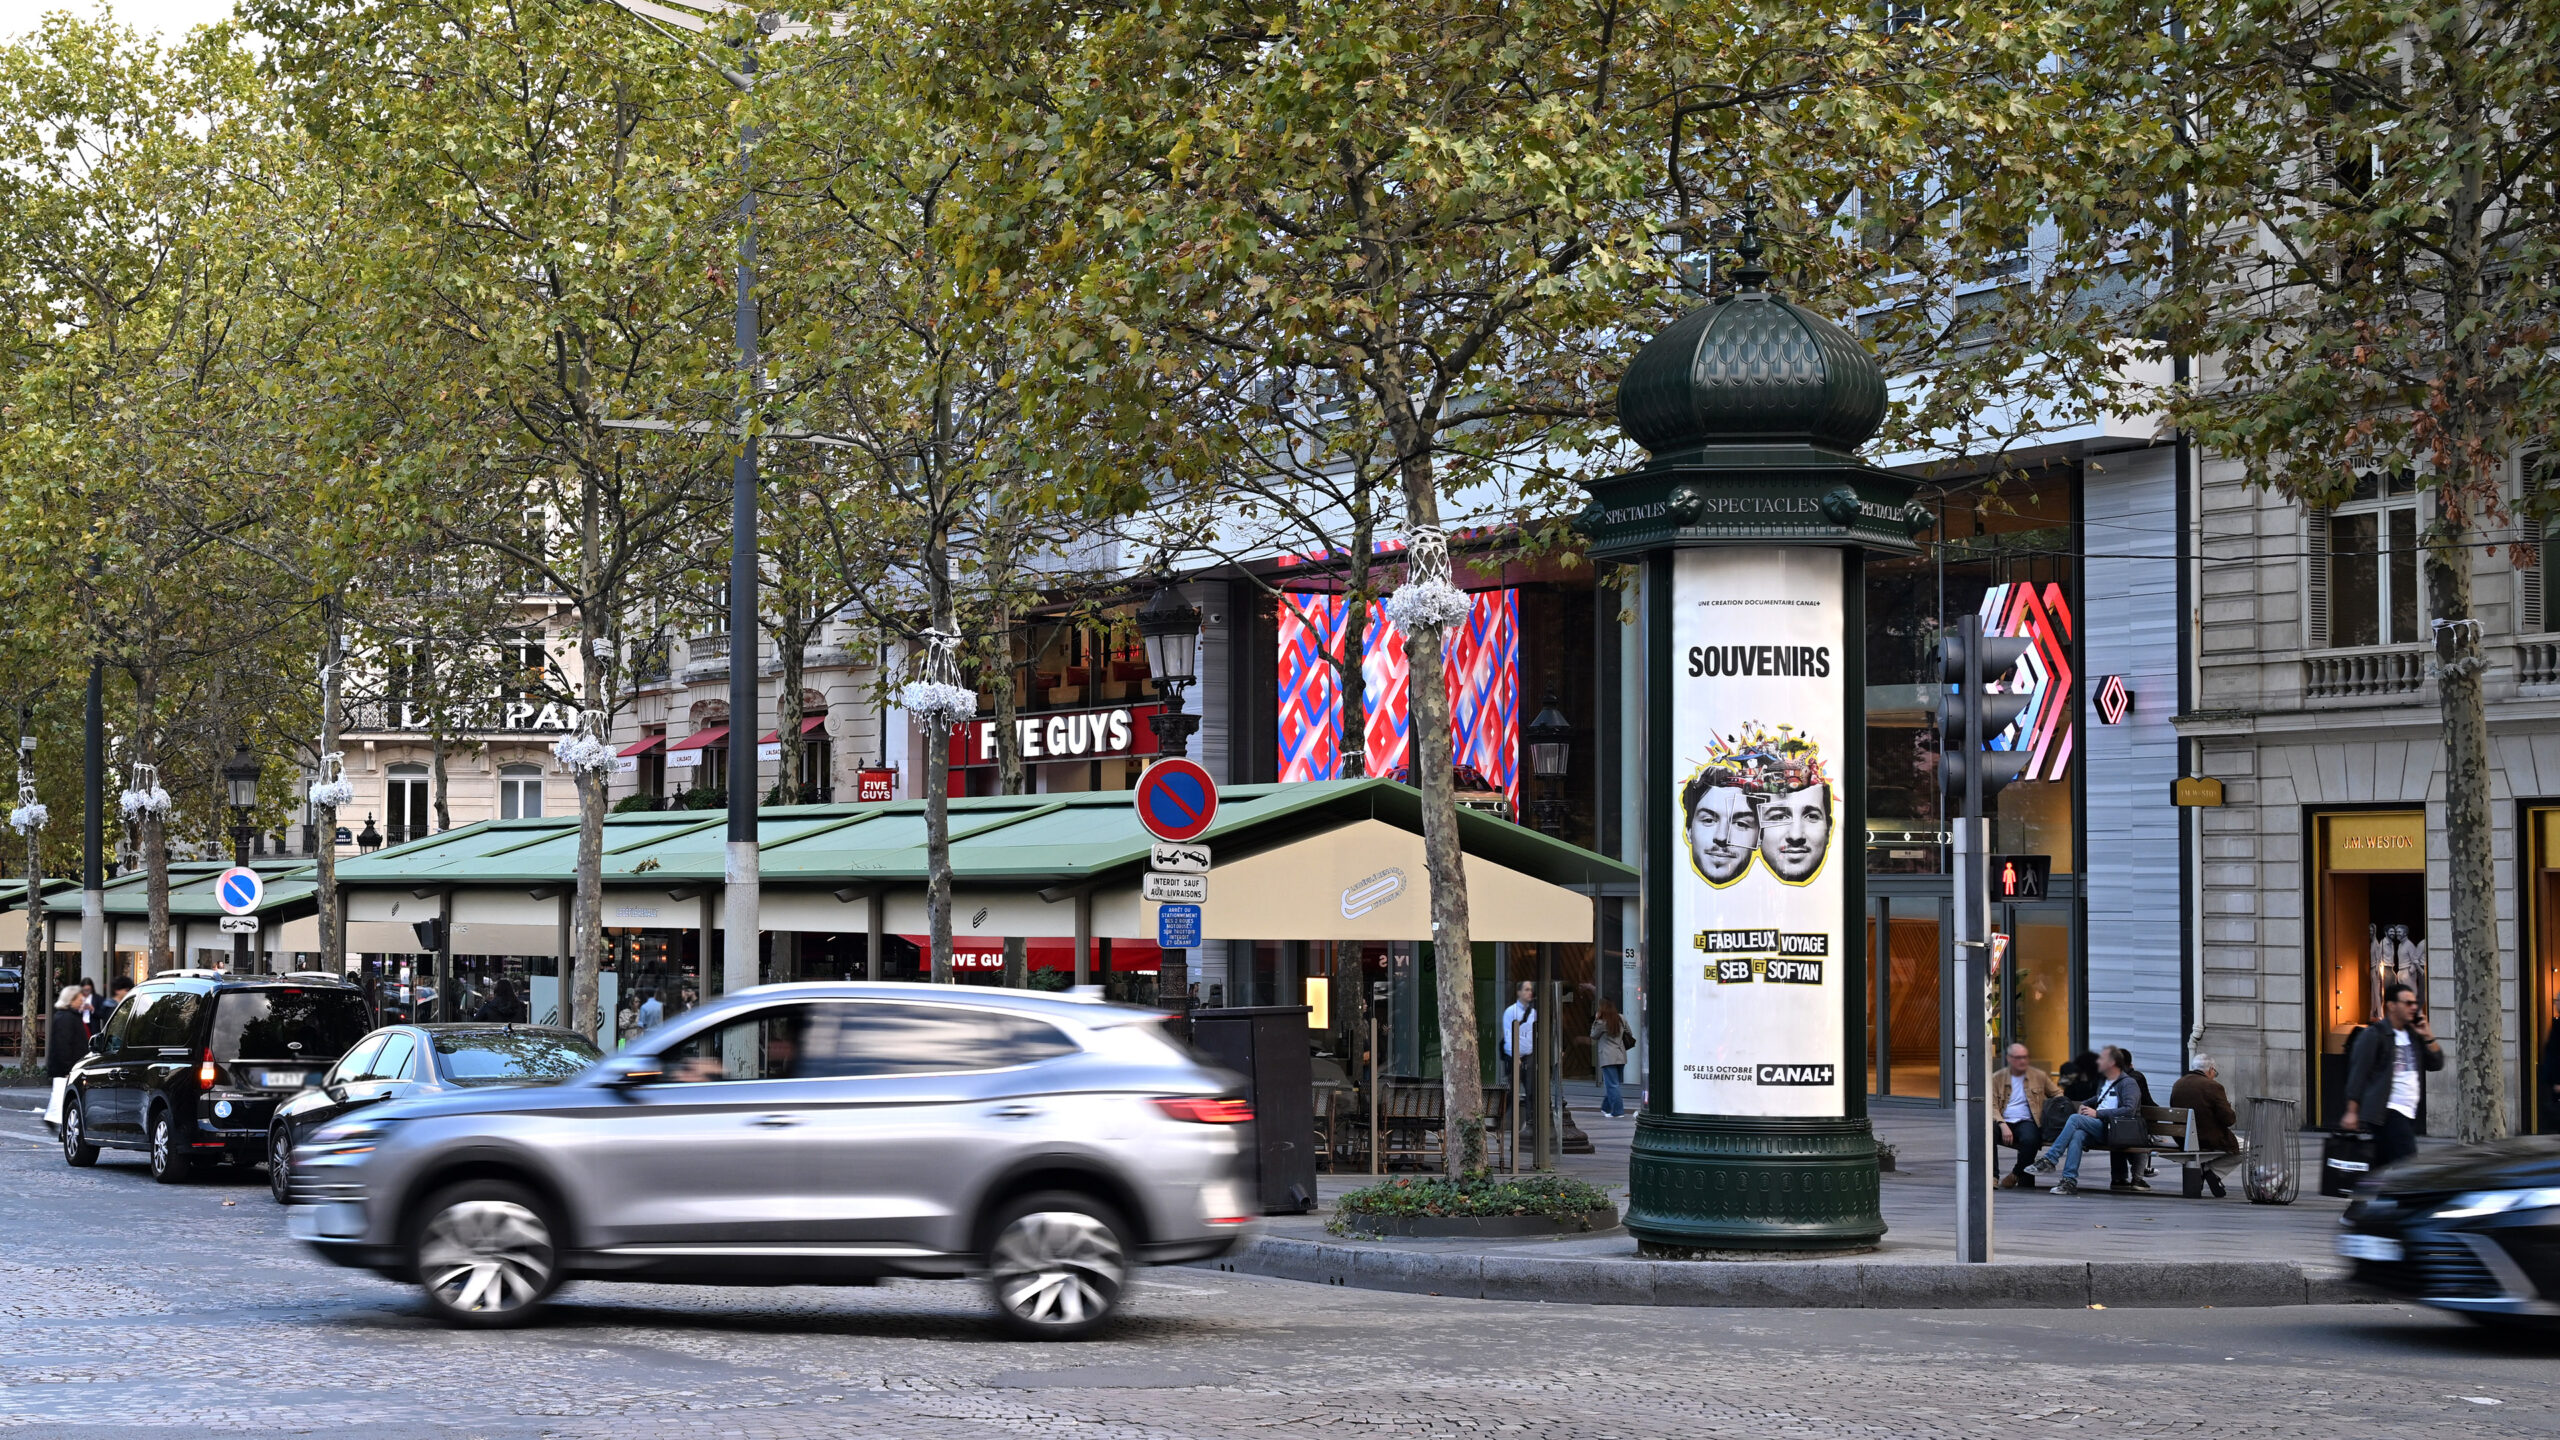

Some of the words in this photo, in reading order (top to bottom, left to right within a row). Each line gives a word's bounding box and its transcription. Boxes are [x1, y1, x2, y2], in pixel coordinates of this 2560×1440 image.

[1707, 498, 1819, 513] SPECTACLES
[1860, 501, 1904, 521] PECTACLES
[1605, 502, 1666, 525] SPECTACLES
[1688, 646, 1830, 678] SOUVENIRS
[1047, 709, 1132, 756] GUYS
[864, 781, 888, 790] FIVE
[861, 790, 891, 800] GUYS
[2343, 836, 2364, 849] J.M.
[2365, 835, 2412, 849] WESTON
[1153, 877, 1180, 887] INTERDIT
[1183, 879, 1200, 888] SAUF
[1151, 888, 1163, 896] AUX
[1167, 889, 1202, 898] LIVRAISONS
[1695, 937, 1705, 947] LE
[1708, 931, 1776, 949] FABULEUX
[1780, 936, 1825, 953] VOYAGE
[951, 953, 977, 967] IVE
[980, 953, 1003, 967] GU
[1625, 948, 1635, 958] 53
[1706, 968, 1716, 978] DE
[1720, 961, 1749, 980] SEB
[1754, 961, 1766, 972] ET
[1767, 961, 1819, 981] SOFYAN
[1706, 1065, 1714, 1073] 15
[1716, 1066, 1753, 1074] OCTOBRE
[1759, 1066, 1833, 1083] CANAL+
[1693, 1072, 1735, 1081] SEULEMENT
[1737, 1074, 1753, 1082] SUR
